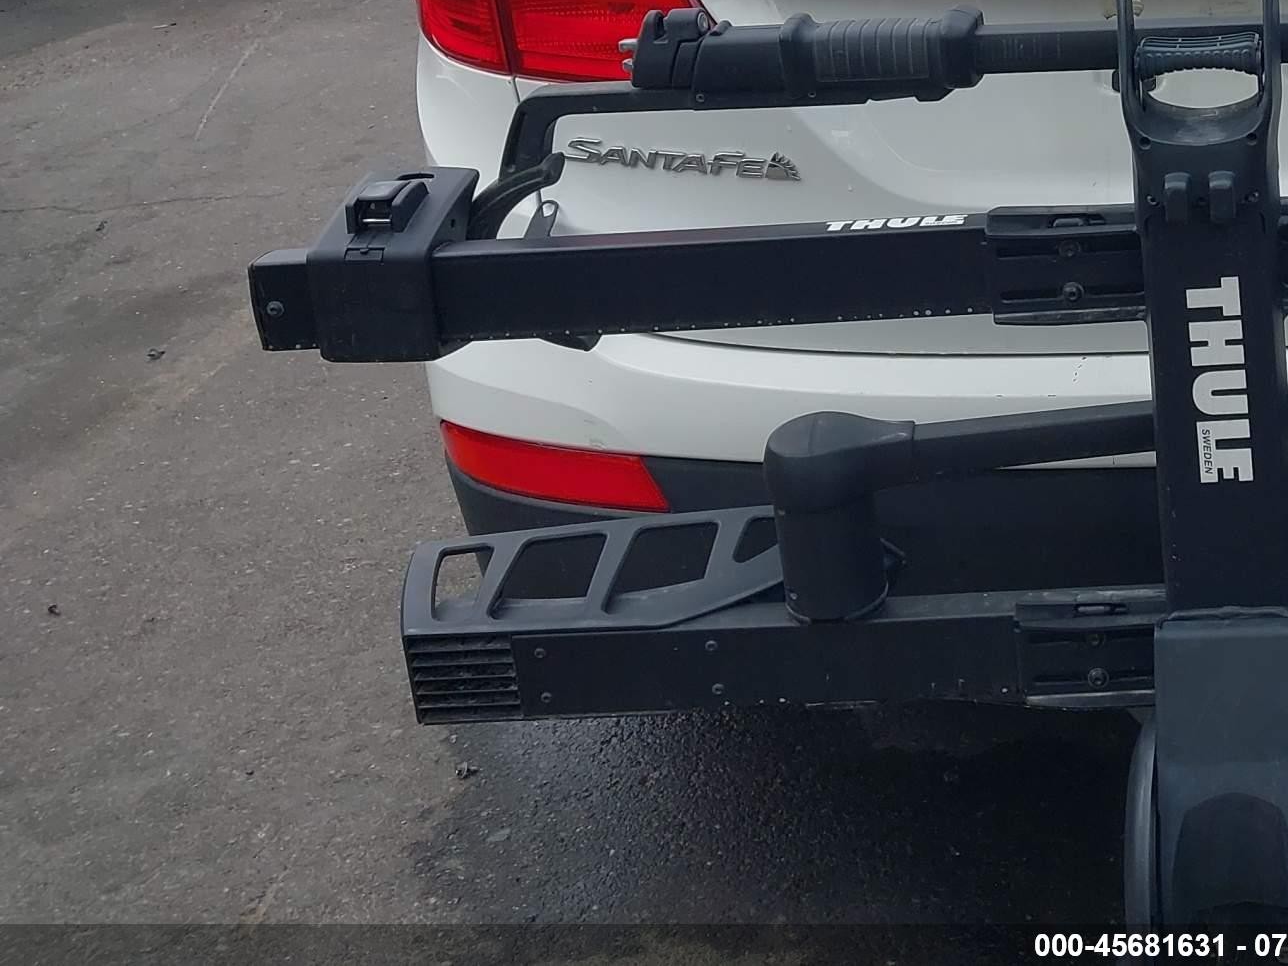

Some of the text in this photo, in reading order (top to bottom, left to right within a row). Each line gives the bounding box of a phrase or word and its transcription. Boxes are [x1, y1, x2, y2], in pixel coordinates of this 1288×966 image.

[826, 214, 968, 232] THULE
[1185, 275, 1254, 484] THULE
[1201, 428, 1214, 475] SWEDEN
